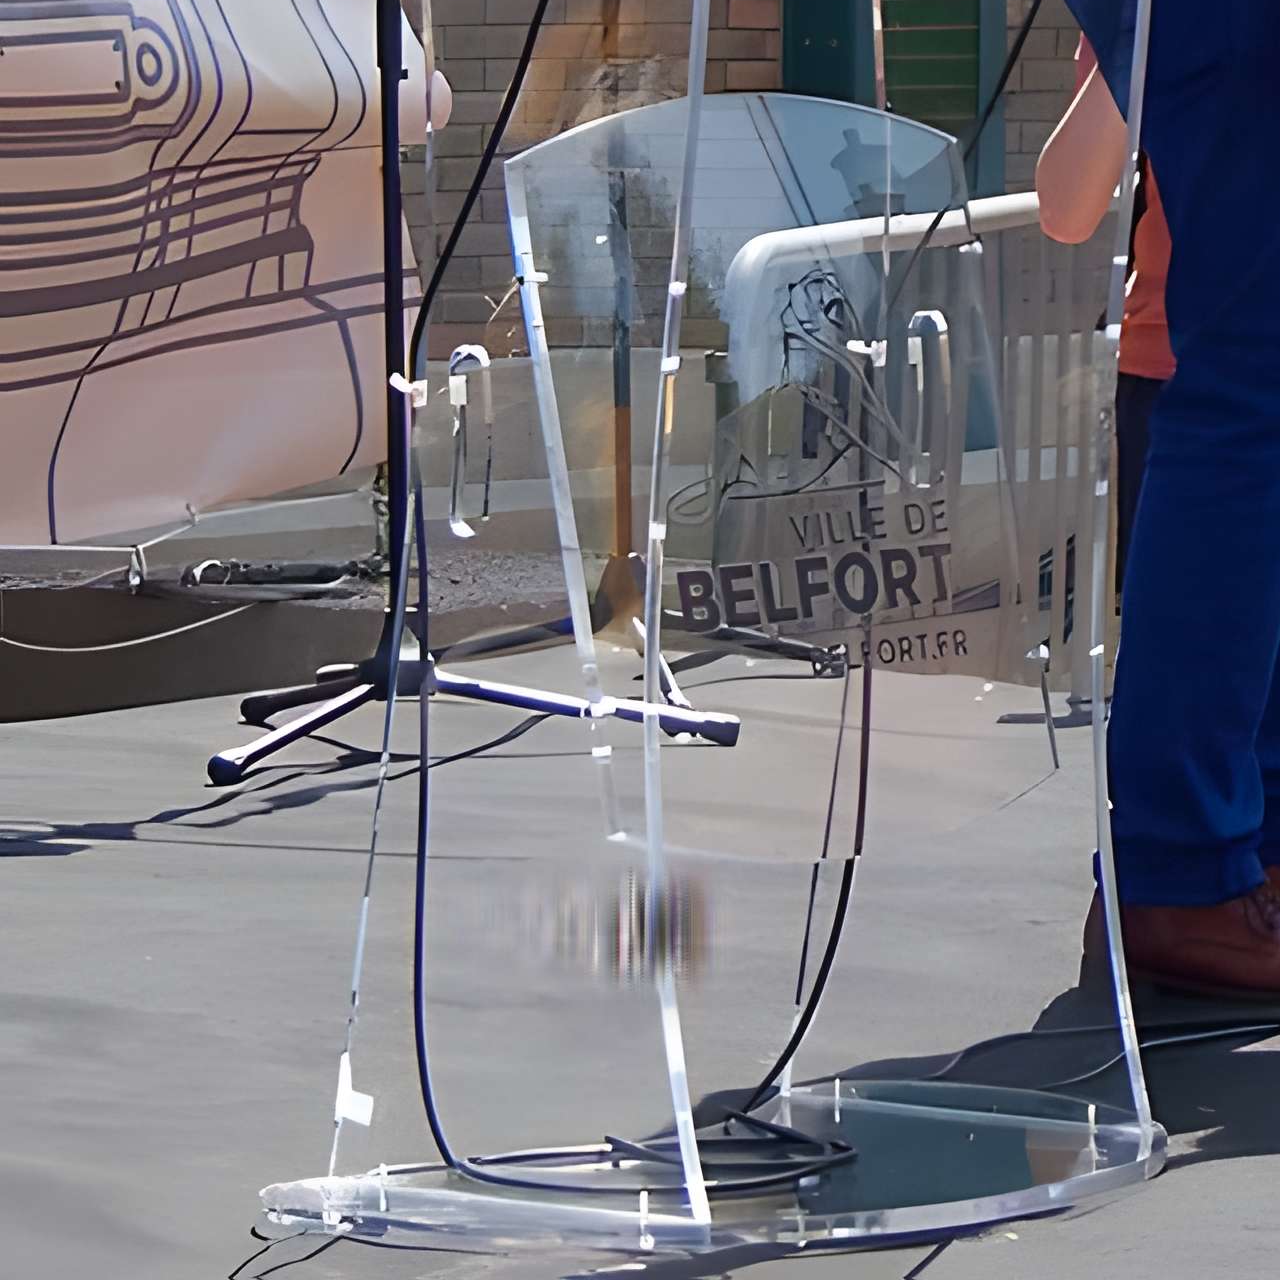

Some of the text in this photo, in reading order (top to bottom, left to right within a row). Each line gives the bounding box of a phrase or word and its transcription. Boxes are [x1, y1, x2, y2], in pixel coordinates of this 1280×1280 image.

[789, 499, 949, 548] VILLE DE
[676, 542, 952, 633] BELFORT
